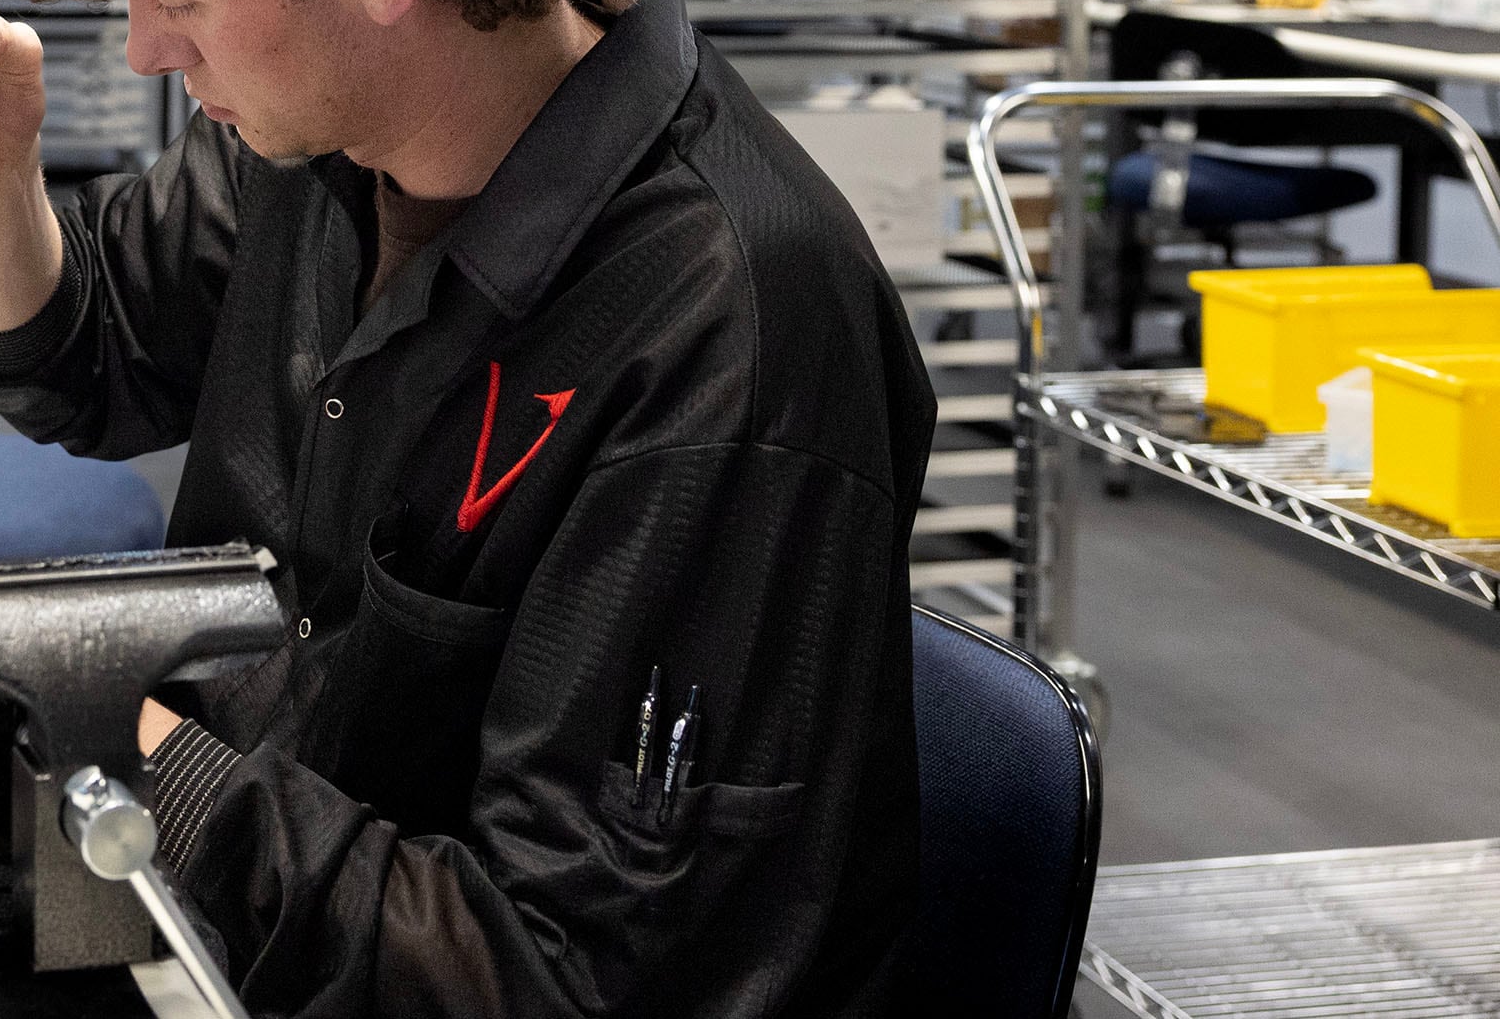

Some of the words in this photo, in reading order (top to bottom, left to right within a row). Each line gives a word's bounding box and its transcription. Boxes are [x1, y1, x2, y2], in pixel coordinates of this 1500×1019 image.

[640, 723, 651, 747] G-2
[636, 747, 646, 774] PILOT
[668, 741, 679, 766] G-2
[664, 766, 674, 792] PILOT
